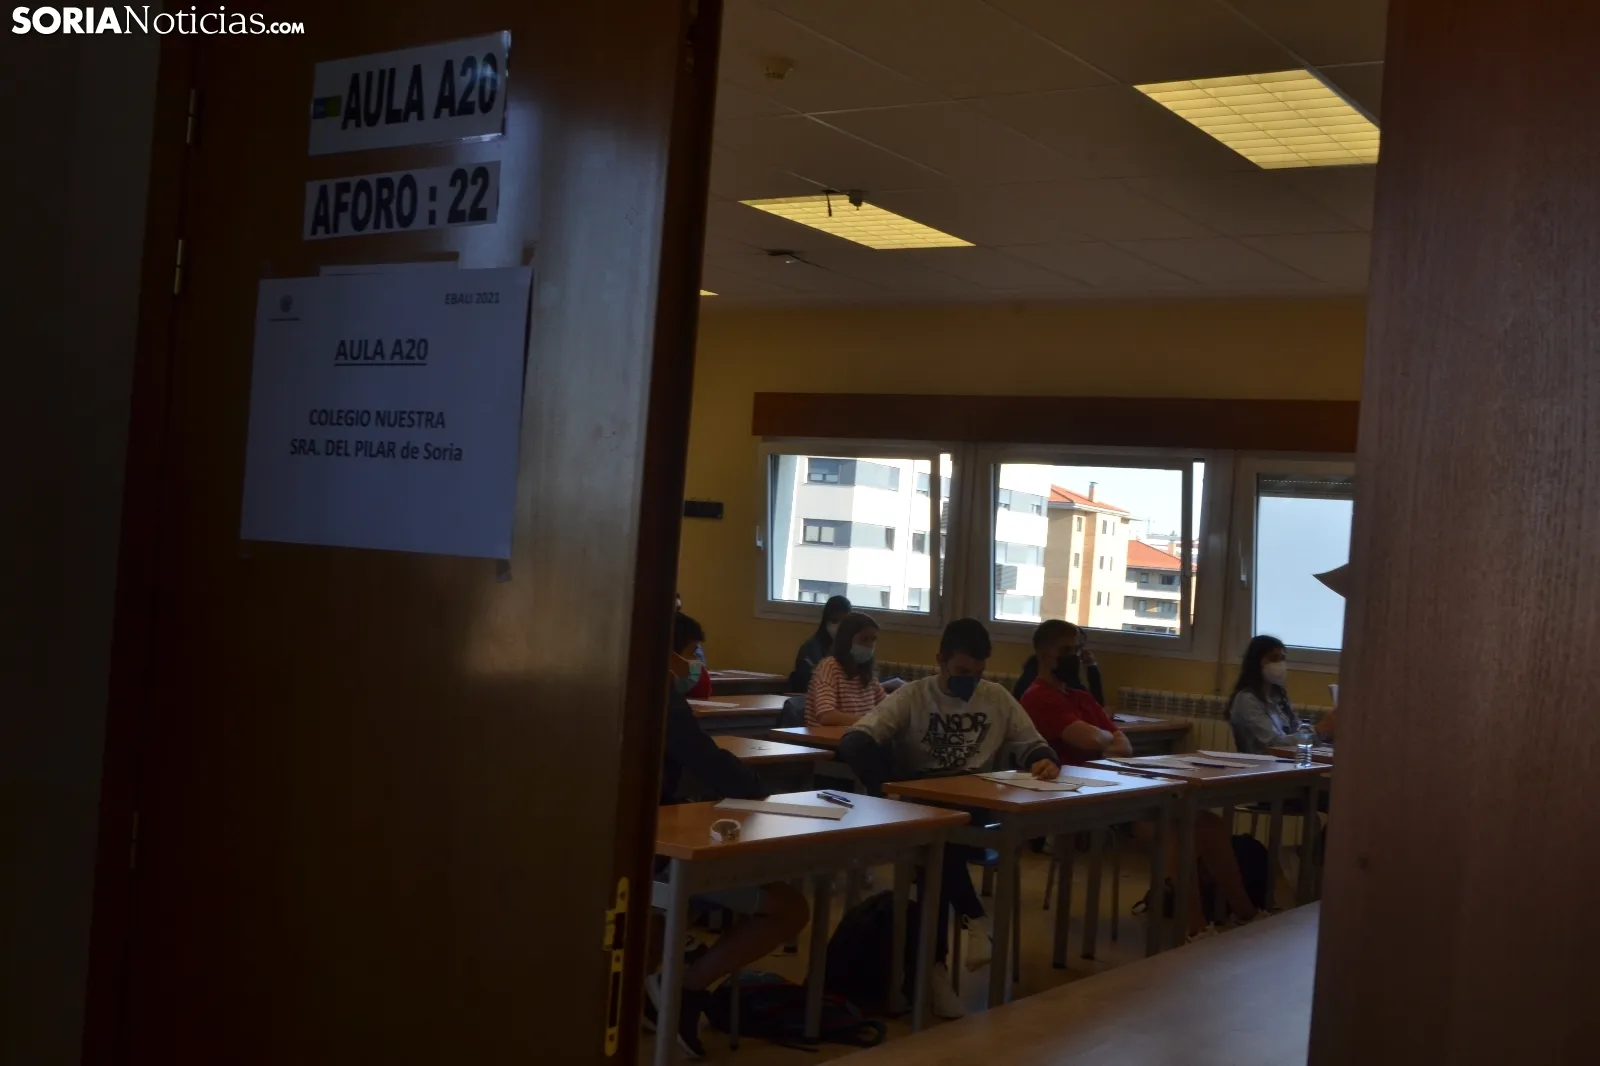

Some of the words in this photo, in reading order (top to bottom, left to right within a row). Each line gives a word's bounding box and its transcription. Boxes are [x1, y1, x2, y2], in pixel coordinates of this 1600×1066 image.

[341, 64, 424, 130] AULA
[433, 53, 497, 119] A20
[310, 174, 418, 236] AFORO
[447, 166, 489, 224] 22
[444, 293, 472, 305] EBAU
[475, 292, 500, 304] 2021
[335, 339, 385, 361] AULA
[391, 338, 429, 361] A20
[309, 408, 371, 427] COLEGIO
[375, 410, 446, 429] NUESTRA
[290, 438, 320, 456] SRA.
[325, 439, 350, 457] DEL
[355, 440, 396, 459] PILAR
[401, 441, 419, 460] de
[423, 442, 463, 462] Soria
